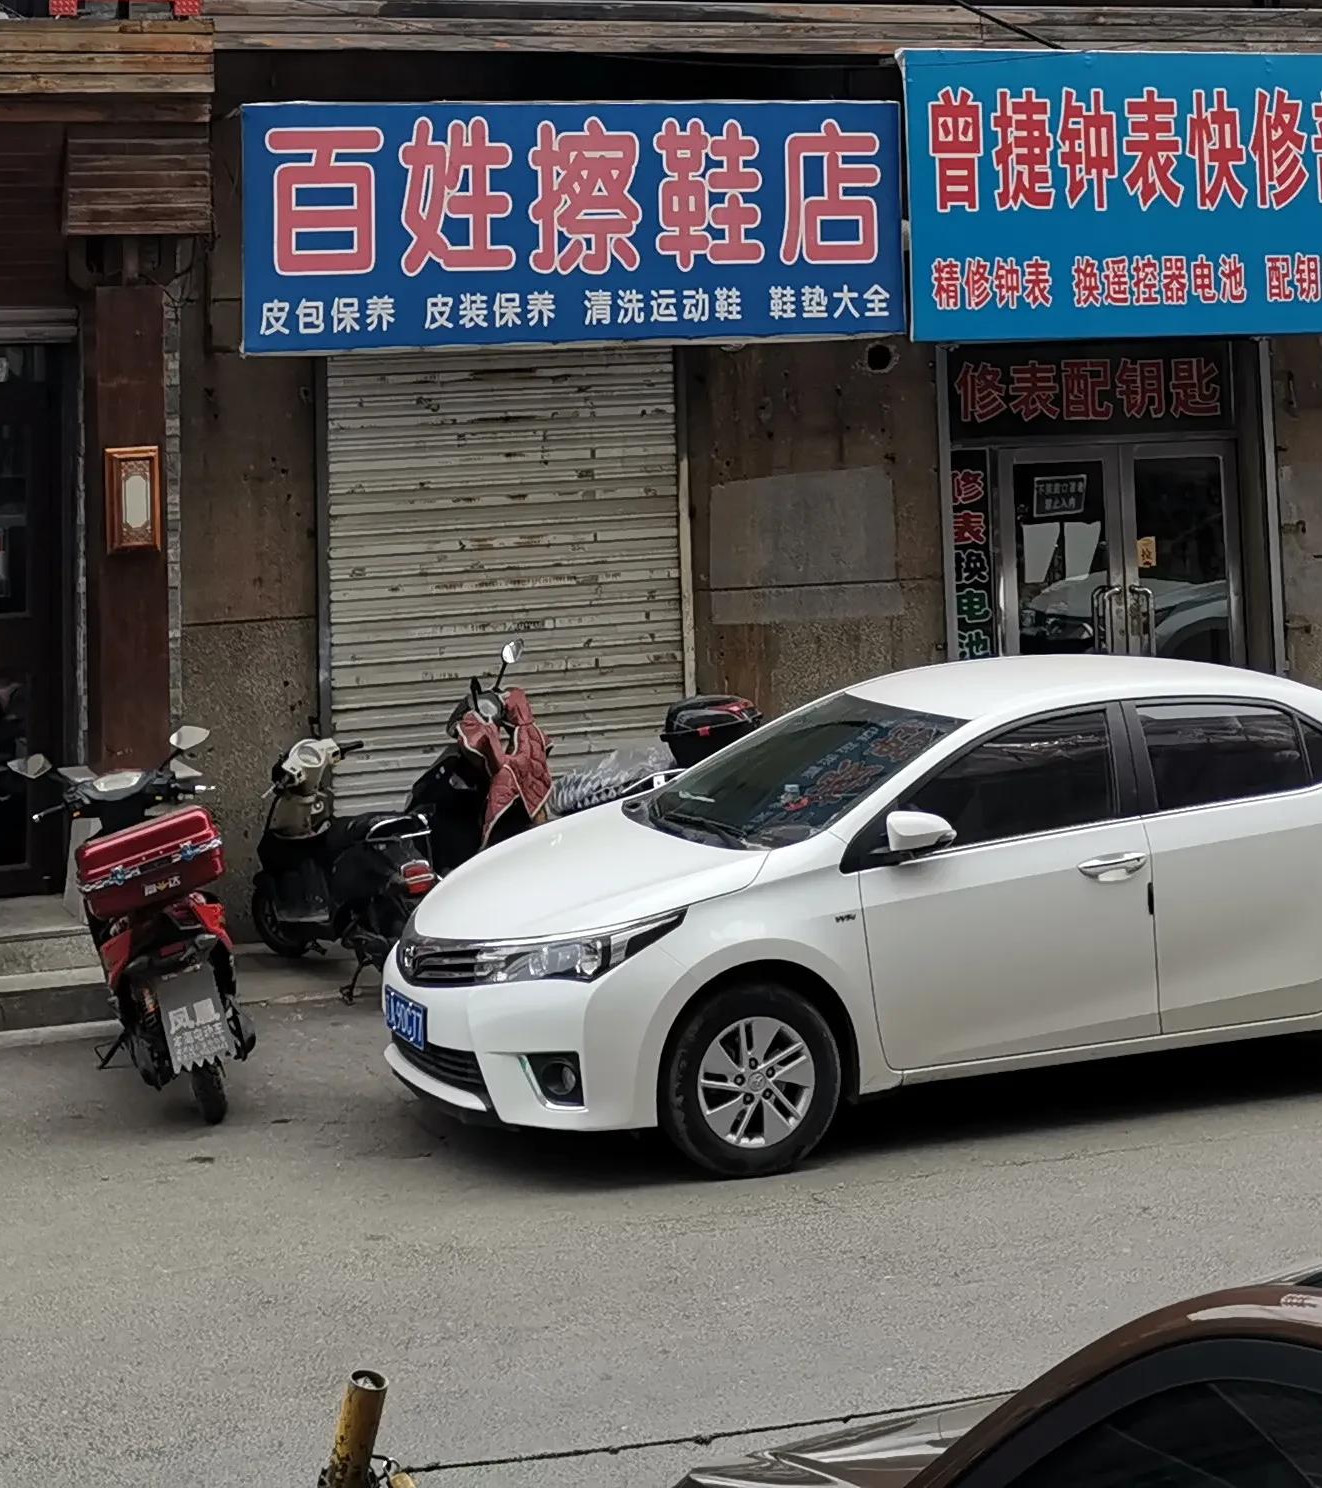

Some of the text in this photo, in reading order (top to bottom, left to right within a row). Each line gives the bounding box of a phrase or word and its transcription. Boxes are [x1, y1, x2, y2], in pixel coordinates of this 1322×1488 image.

[264, 115, 882, 276] 百姓擦鞋店
[259, 284, 891, 337] 皮包保养 皮装保养 清洗运动鞋 鞋垫大全
[931, 256, 1053, 310] 精修钟表
[1072, 253, 1248, 308] 换遥控器电池
[955, 357, 1222, 423] 修表配钥匙
